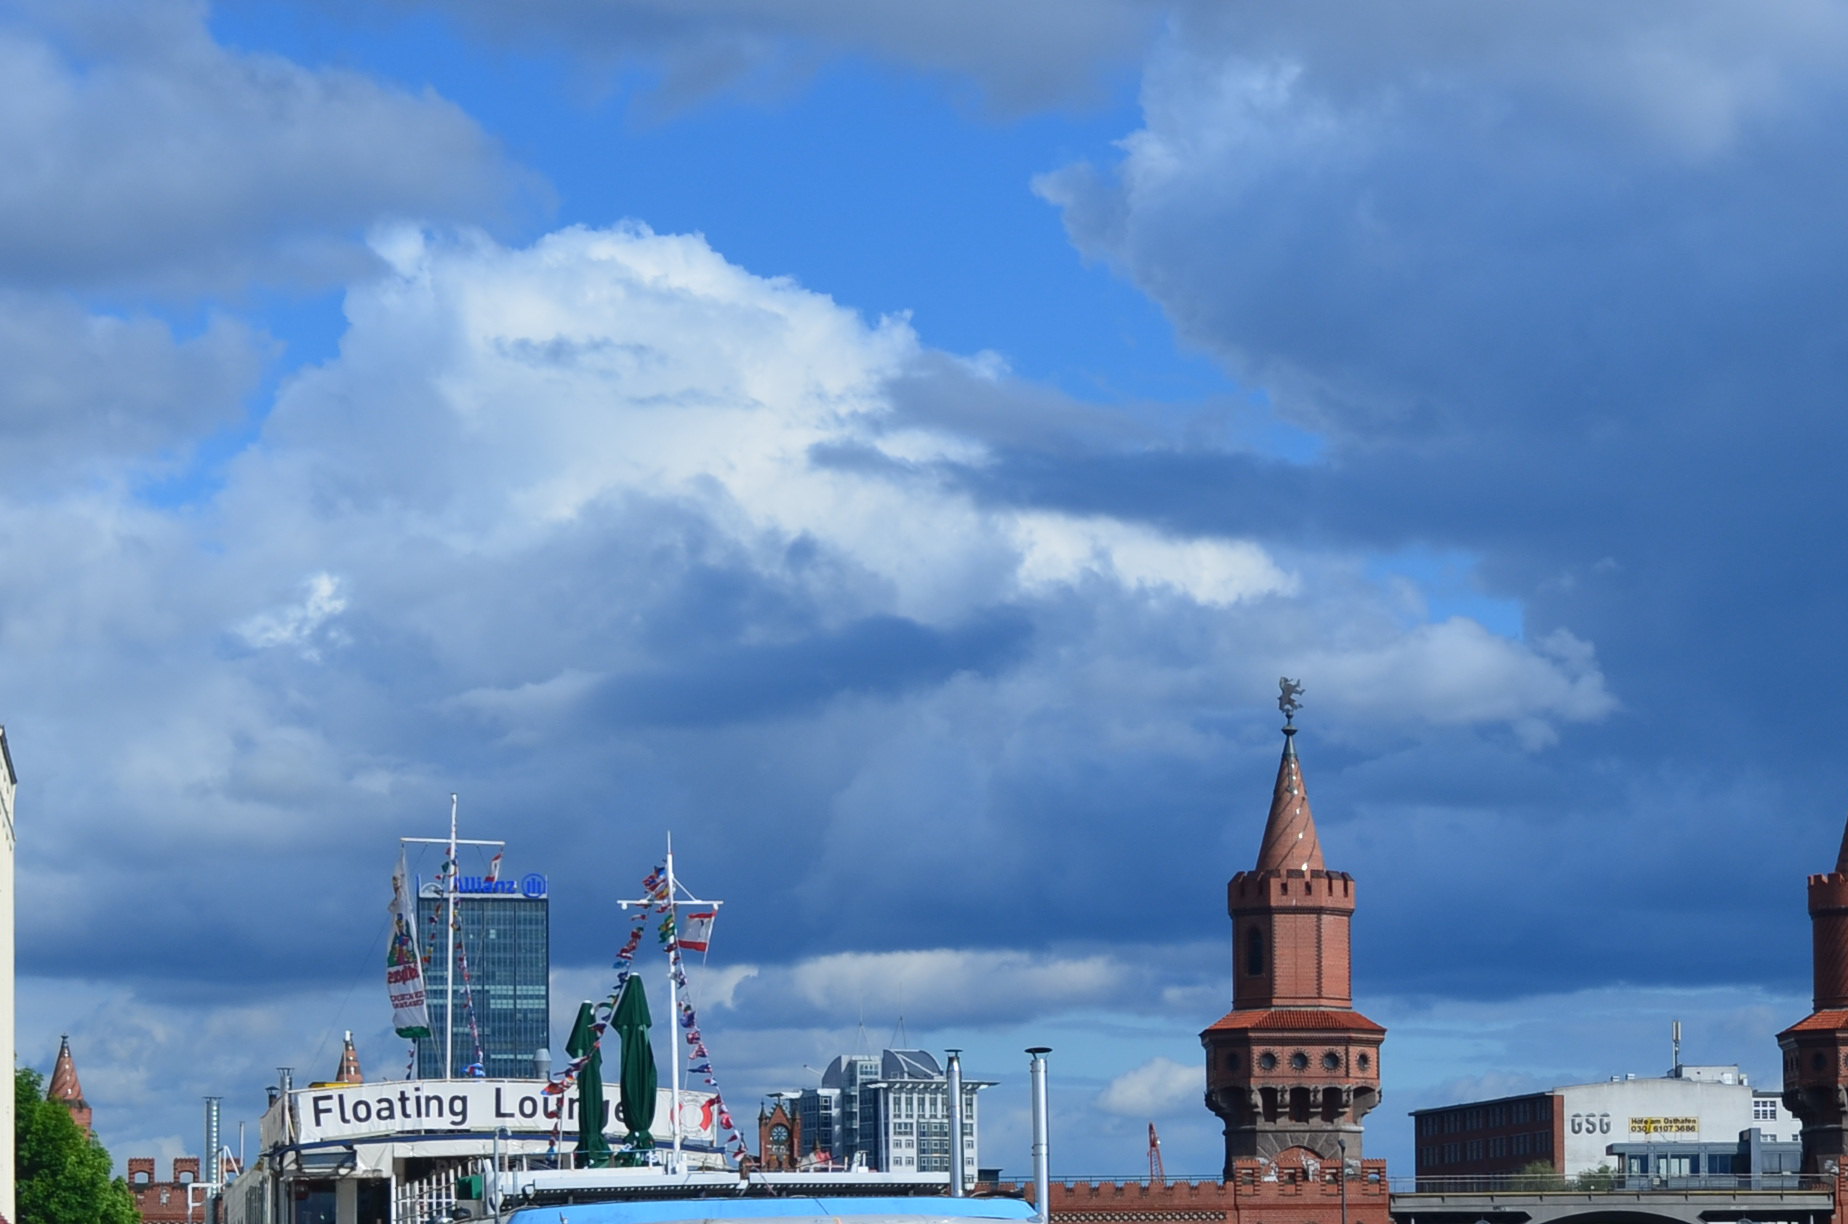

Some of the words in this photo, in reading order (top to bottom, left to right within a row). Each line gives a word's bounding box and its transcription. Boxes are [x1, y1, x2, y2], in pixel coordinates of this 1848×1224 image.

[455, 875, 517, 894] Allianz
[312, 1086, 468, 1127] Floating
[1571, 1112, 1611, 1135] GSG
[1664, 1117, 1697, 1125] Osthafen
